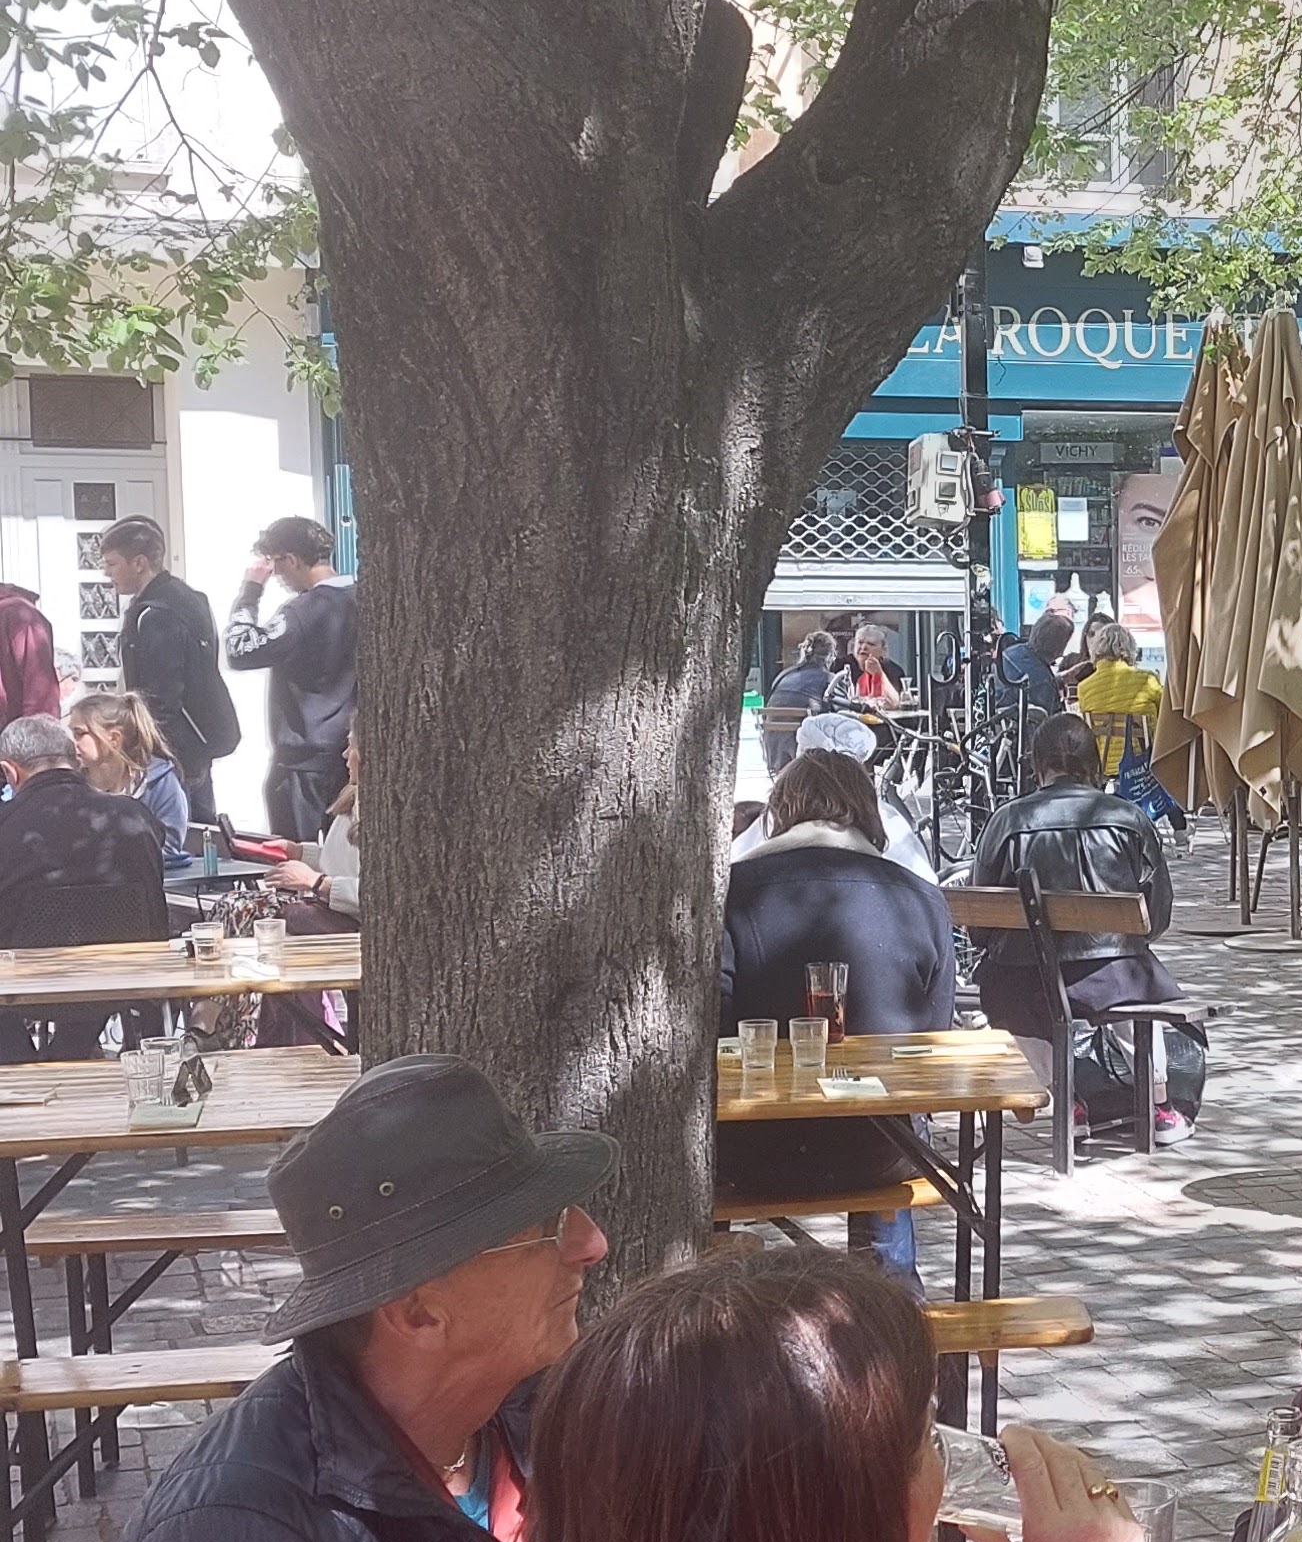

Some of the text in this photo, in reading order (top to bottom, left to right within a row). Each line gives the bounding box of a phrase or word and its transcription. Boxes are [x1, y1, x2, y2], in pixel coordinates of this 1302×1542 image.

[1055, 445, 1099, 457] VICHY
[1122, 552, 1137, 562] LES
[1138, 552, 1152, 562] TA
